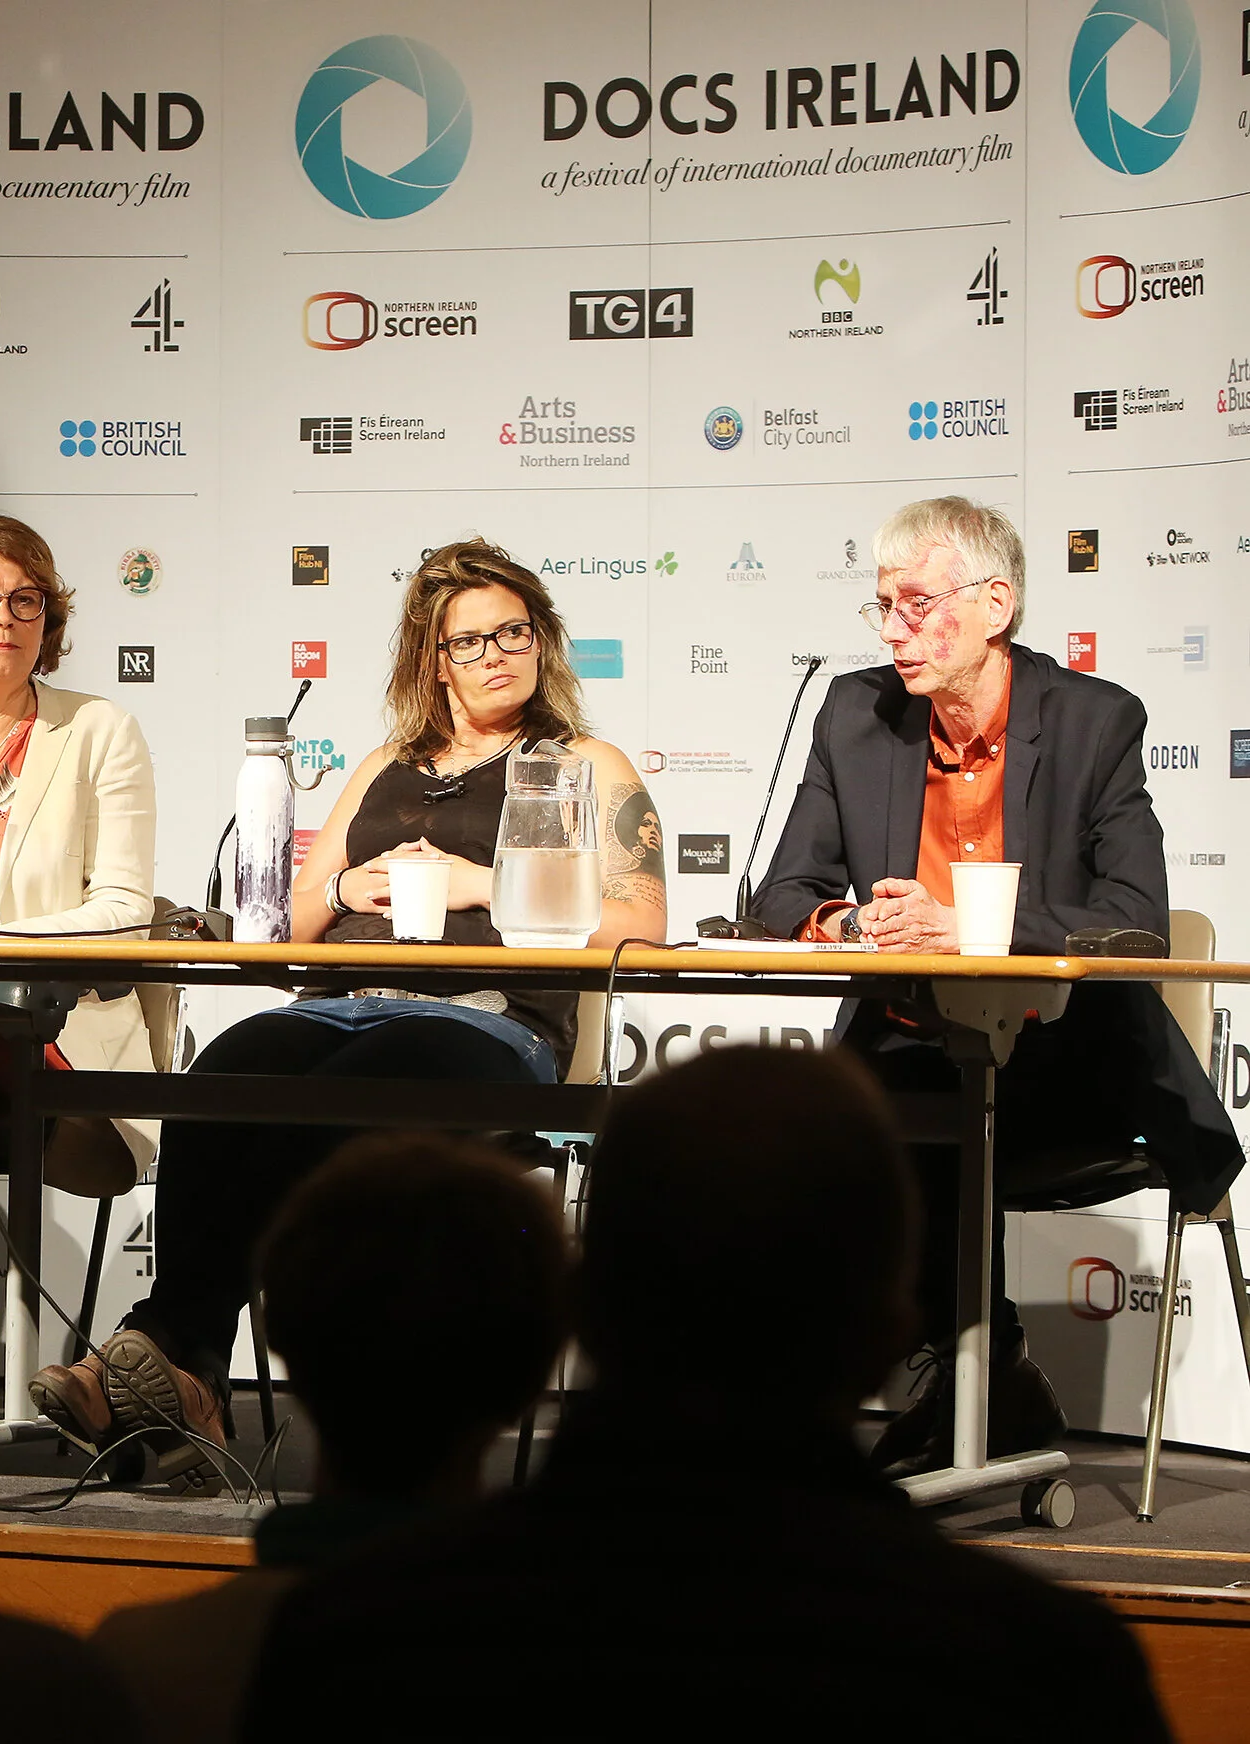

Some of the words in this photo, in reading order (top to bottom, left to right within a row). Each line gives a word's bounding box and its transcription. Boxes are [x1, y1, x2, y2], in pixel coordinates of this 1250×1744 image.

[544, 73, 737, 141] DOCS
[765, 48, 1020, 131] IRELAND
[541, 169, 559, 189] a
[556, 158, 652, 197] festival
[654, 157, 683, 192] of
[682, 147, 832, 182] international
[835, 142, 973, 175] documentary
[968, 134, 1013, 172] film
[134, 174, 191, 206] film
[1140, 262, 1175, 275] NORTHERN
[1177, 258, 1204, 272] IRELAND
[1141, 271, 1204, 302] screen
[384, 303, 435, 313] NORTHERN
[438, 301, 477, 312] IRELAND
[574, 294, 687, 335] TG4
[384, 314, 477, 337] screen
[822, 311, 852, 323] BBC
[789, 328, 841, 339] NORTHERN
[844, 325, 883, 337] IRELAND
[1227, 358, 1250, 384] Art
[1140, 385, 1170, 400] Éireann
[519, 396, 576, 419] Arts
[944, 399, 1006, 419] BRITISH
[1122, 400, 1153, 415] Screen
[1155, 399, 1184, 413] Ireland
[380, 414, 424, 427] Éireann
[764, 409, 819, 426] Belfast
[103, 422, 182, 439] BRITISH
[359, 429, 400, 441] Screen
[404, 428, 446, 441] Ireland
[499, 420, 636, 446] &Business
[943, 418, 1009, 438] COUNCIL
[764, 428, 791, 450] City
[795, 425, 851, 445] Council
[102, 440, 187, 457] COUNCIL
[520, 454, 579, 467] Northern
[583, 454, 630, 467] Ireland
[1237, 535, 1250, 553] Ae
[540, 558, 576, 575] Aer
[580, 558, 647, 580] Lingus
[726, 572, 767, 582] EUROPA
[816, 571, 847, 580] GRAND
[848, 569, 877, 579] CENTR
[294, 643, 307, 652] KA
[294, 651, 321, 660] BOOM
[691, 645, 723, 659] Fine
[123, 652, 151, 672] NR
[691, 660, 728, 674] Point
[1151, 745, 1198, 769] ODEON
[607, 809, 616, 841] POWER
